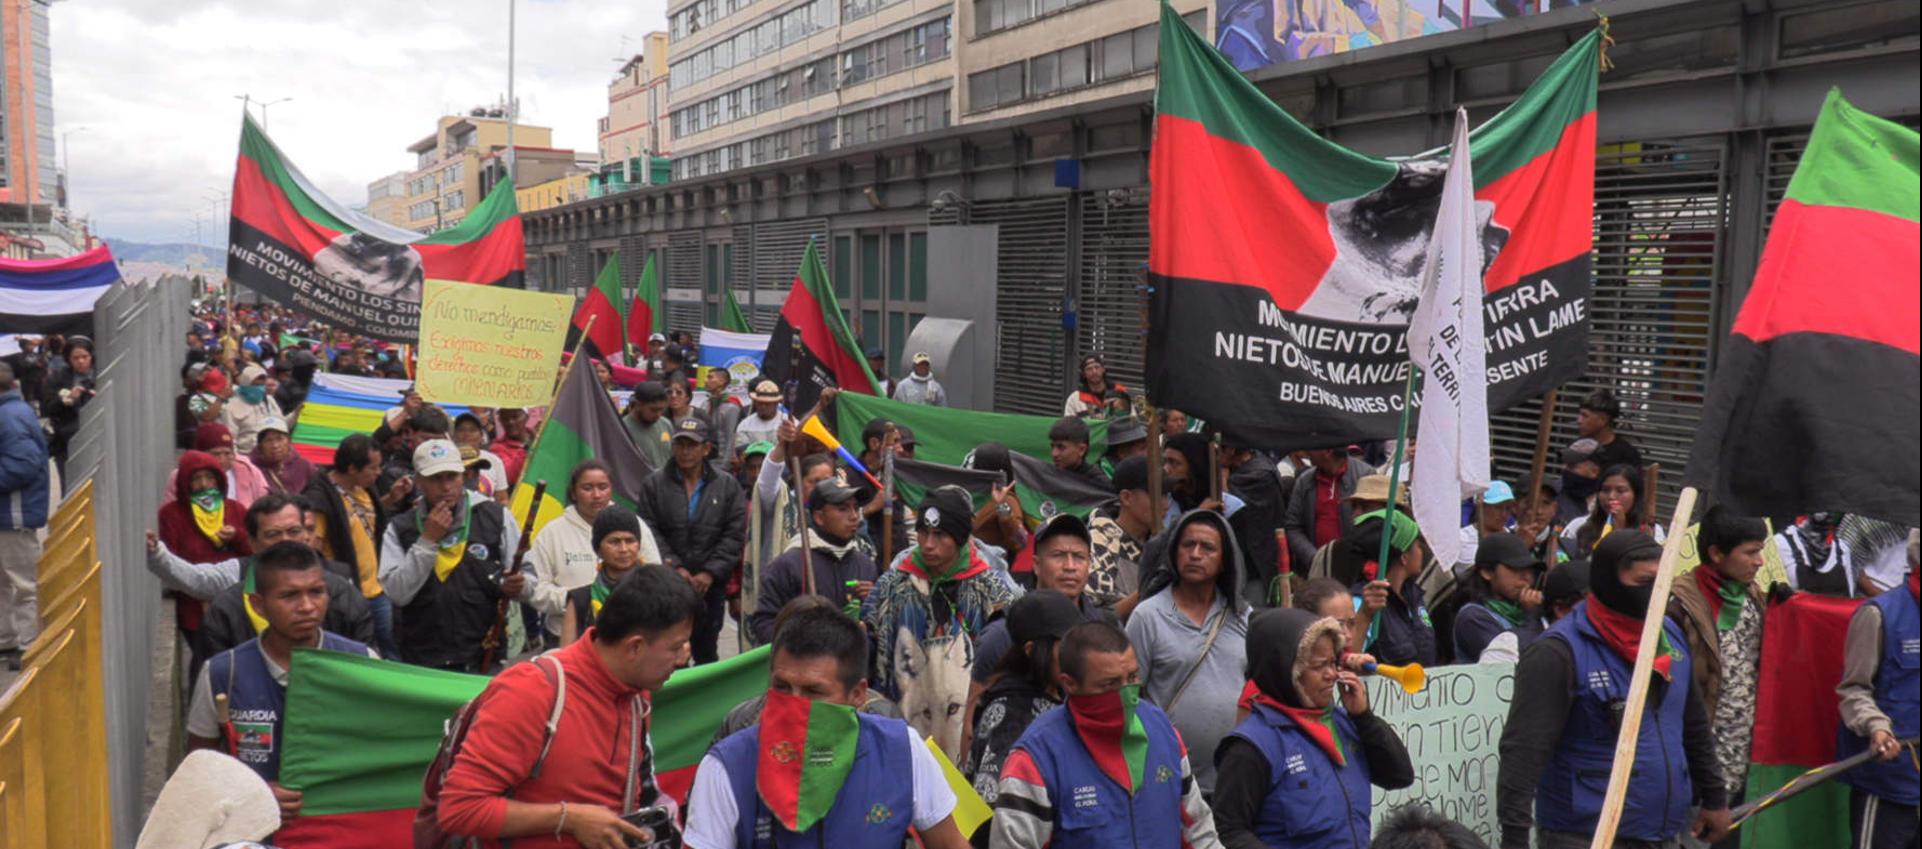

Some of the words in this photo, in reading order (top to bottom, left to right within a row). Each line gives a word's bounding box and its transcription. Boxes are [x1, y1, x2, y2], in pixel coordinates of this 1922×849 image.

[229, 243, 288, 281] NIETOS
[289, 275, 311, 294] DE
[314, 289, 385, 324] MANUEL
[257, 241, 357, 301] MOVIMIENTO
[360, 293, 394, 312] LOS
[365, 323, 419, 338] COLOMB
[433, 299, 458, 321] No
[1327, 360, 1421, 384] MANUE
[1528, 297, 1586, 338] LAME
[1343, 396, 1389, 414] AIRES
